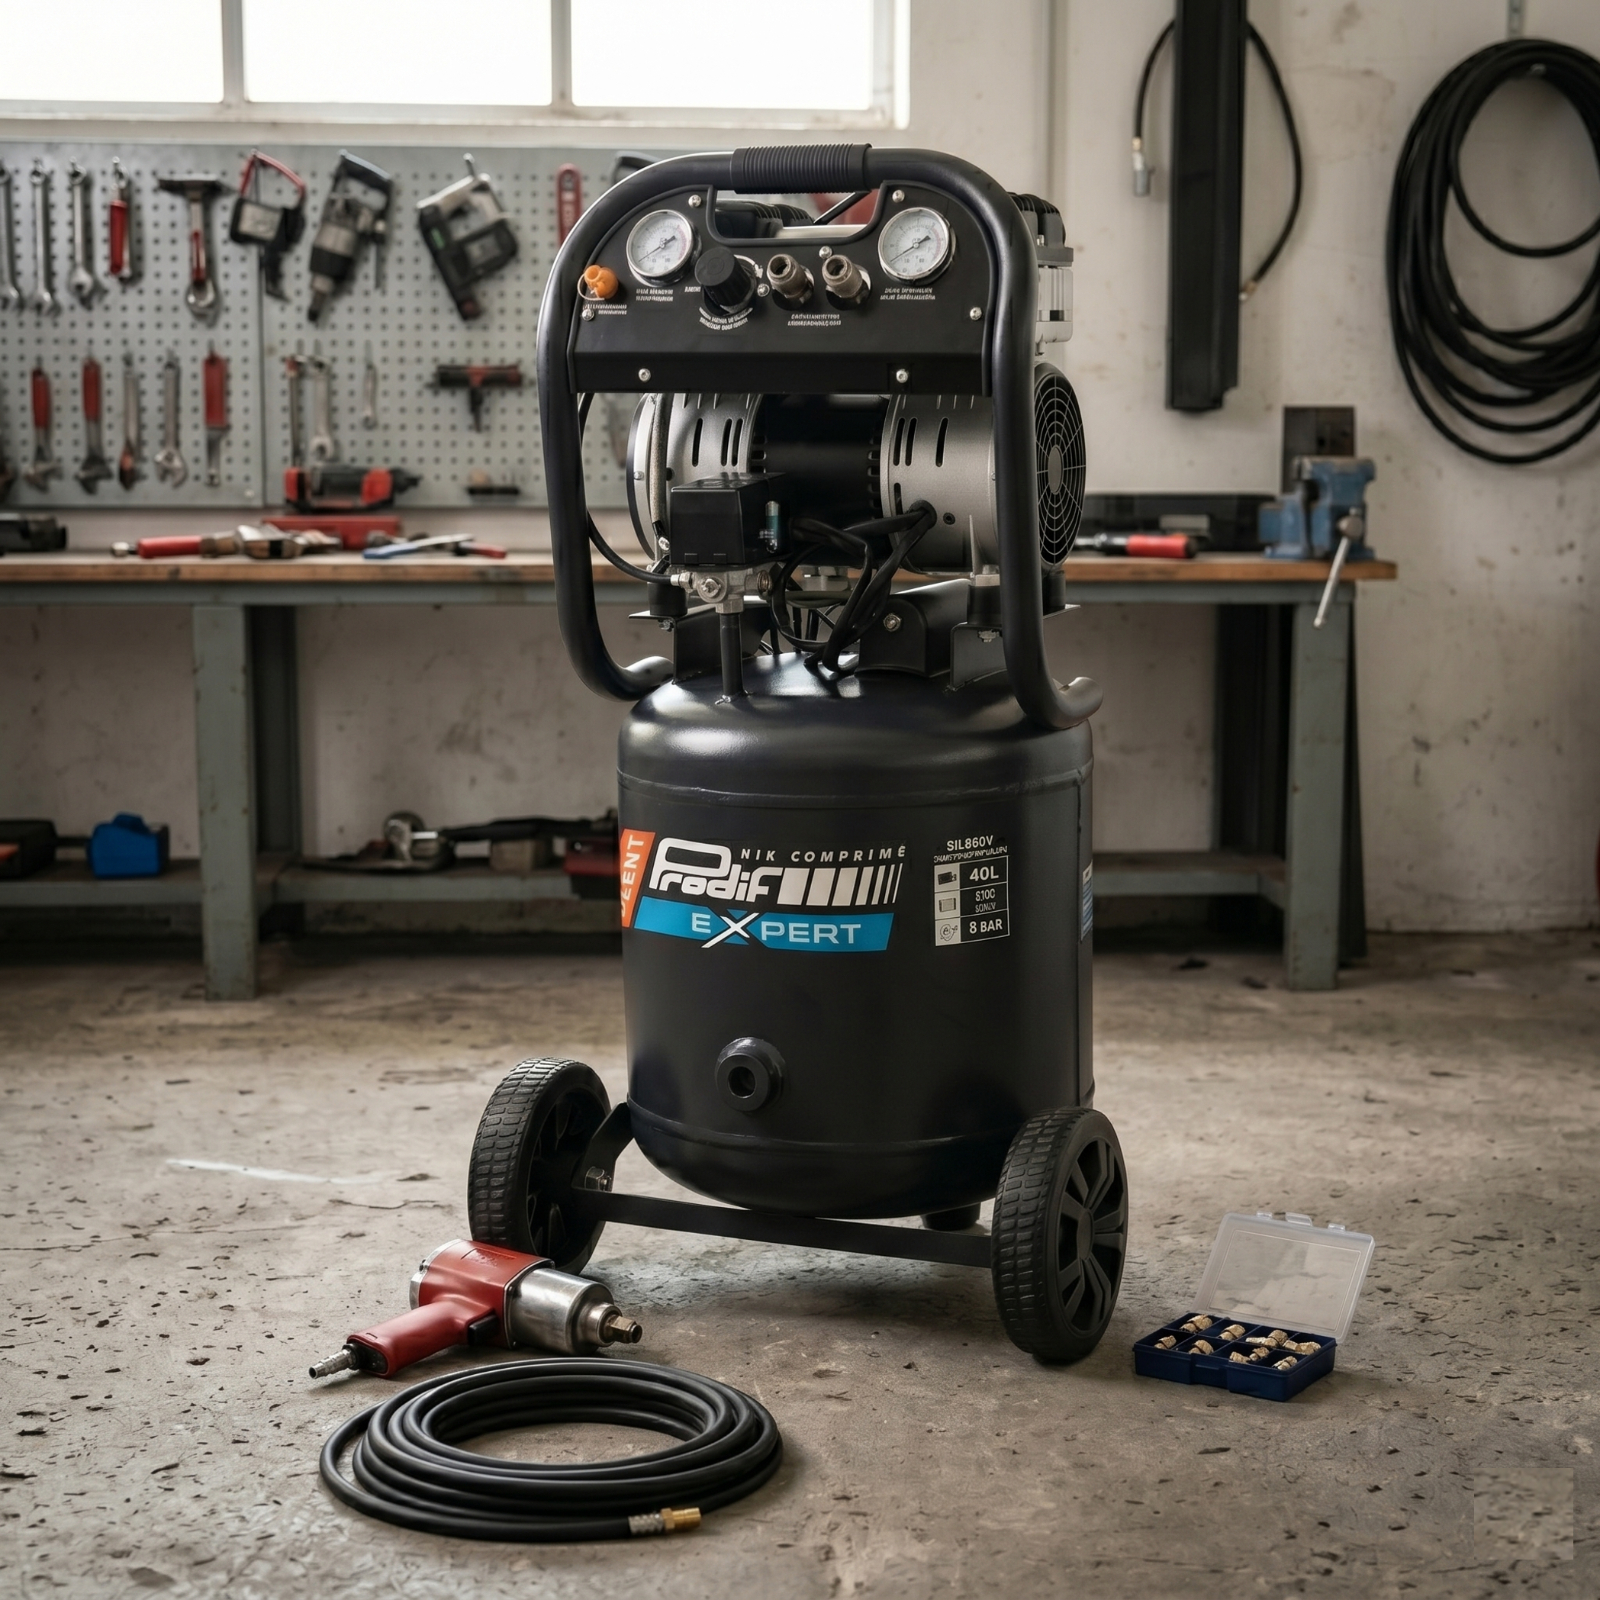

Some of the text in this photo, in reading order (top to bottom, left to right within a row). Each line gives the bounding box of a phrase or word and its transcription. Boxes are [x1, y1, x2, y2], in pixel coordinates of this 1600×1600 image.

[946, 835, 994, 851] SIL860V
[740, 848, 776, 861] NIK
[969, 865, 999, 882] 40L
[691, 912, 861, 948] EXPERT
[969, 918, 1003, 934] 8 BAR
